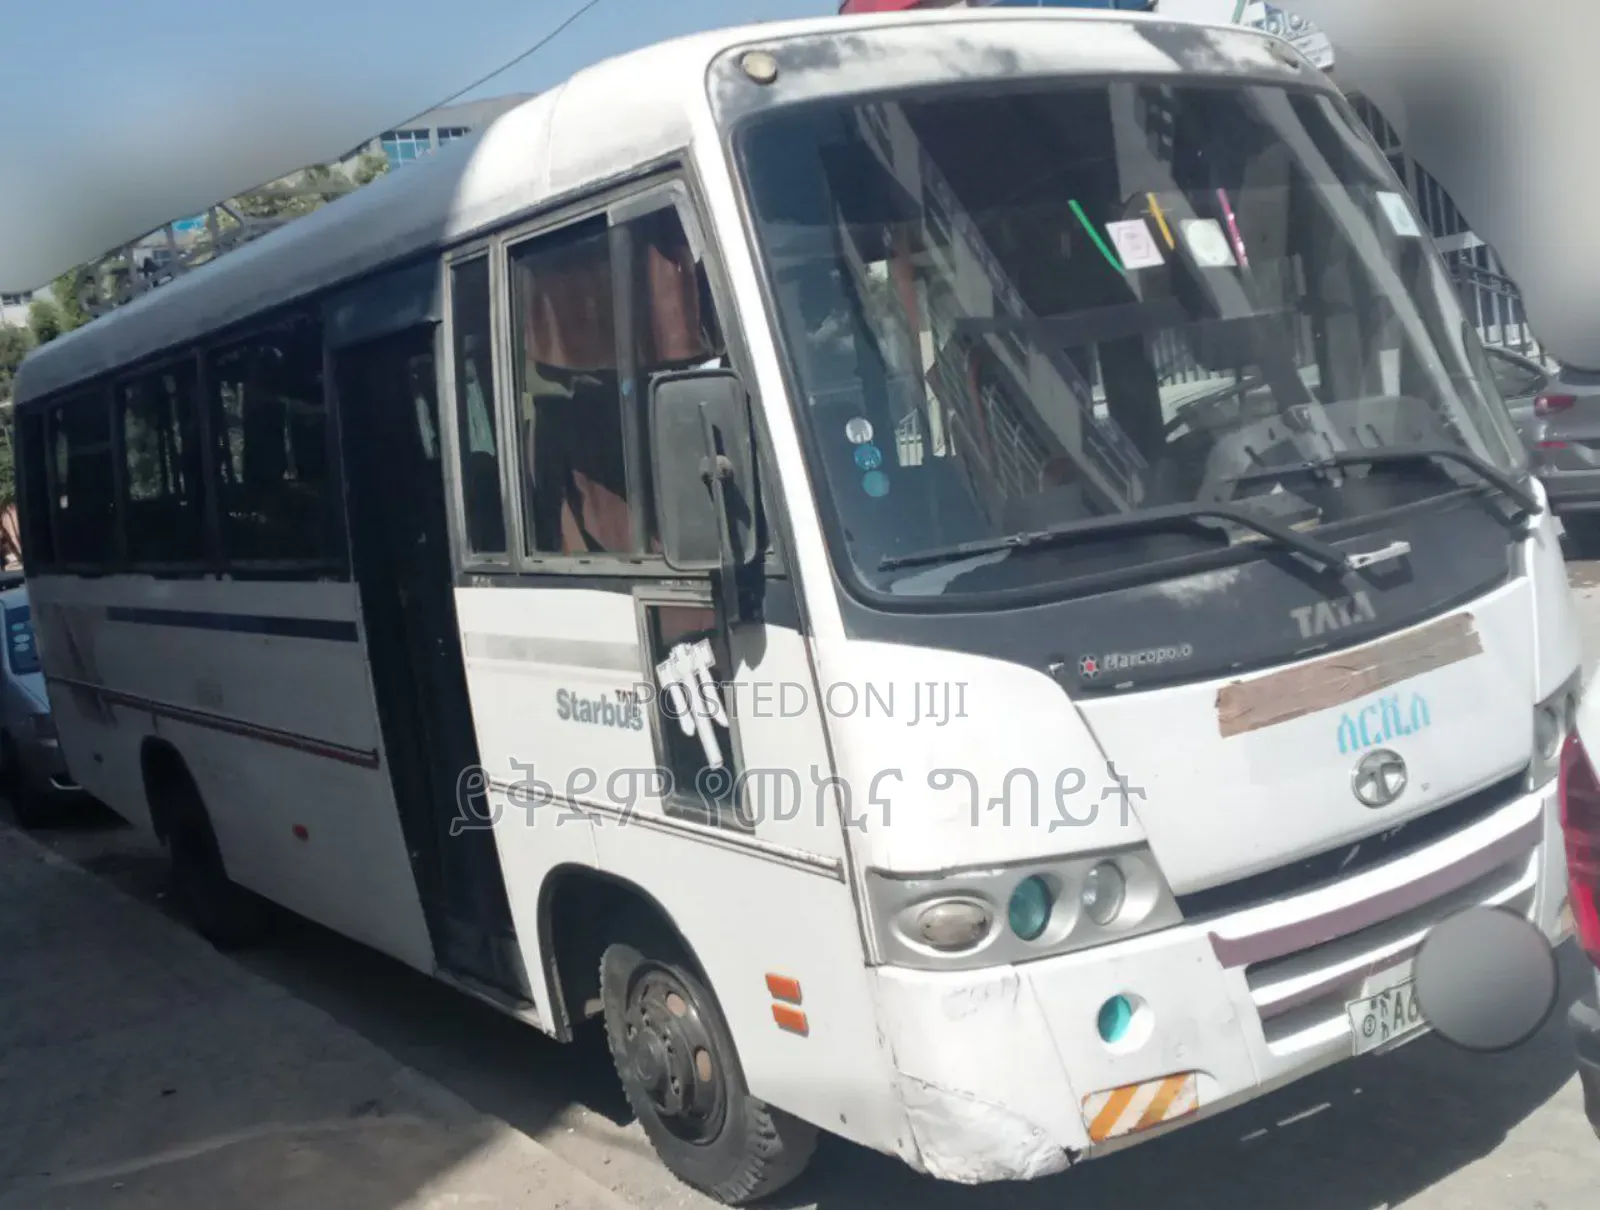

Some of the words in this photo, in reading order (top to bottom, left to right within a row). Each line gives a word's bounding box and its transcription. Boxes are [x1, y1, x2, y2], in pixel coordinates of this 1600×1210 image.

[1290, 591, 1376, 639] TATA
[1104, 644, 1193, 670] Marcopoo
[556, 688, 644, 731] Starbus
